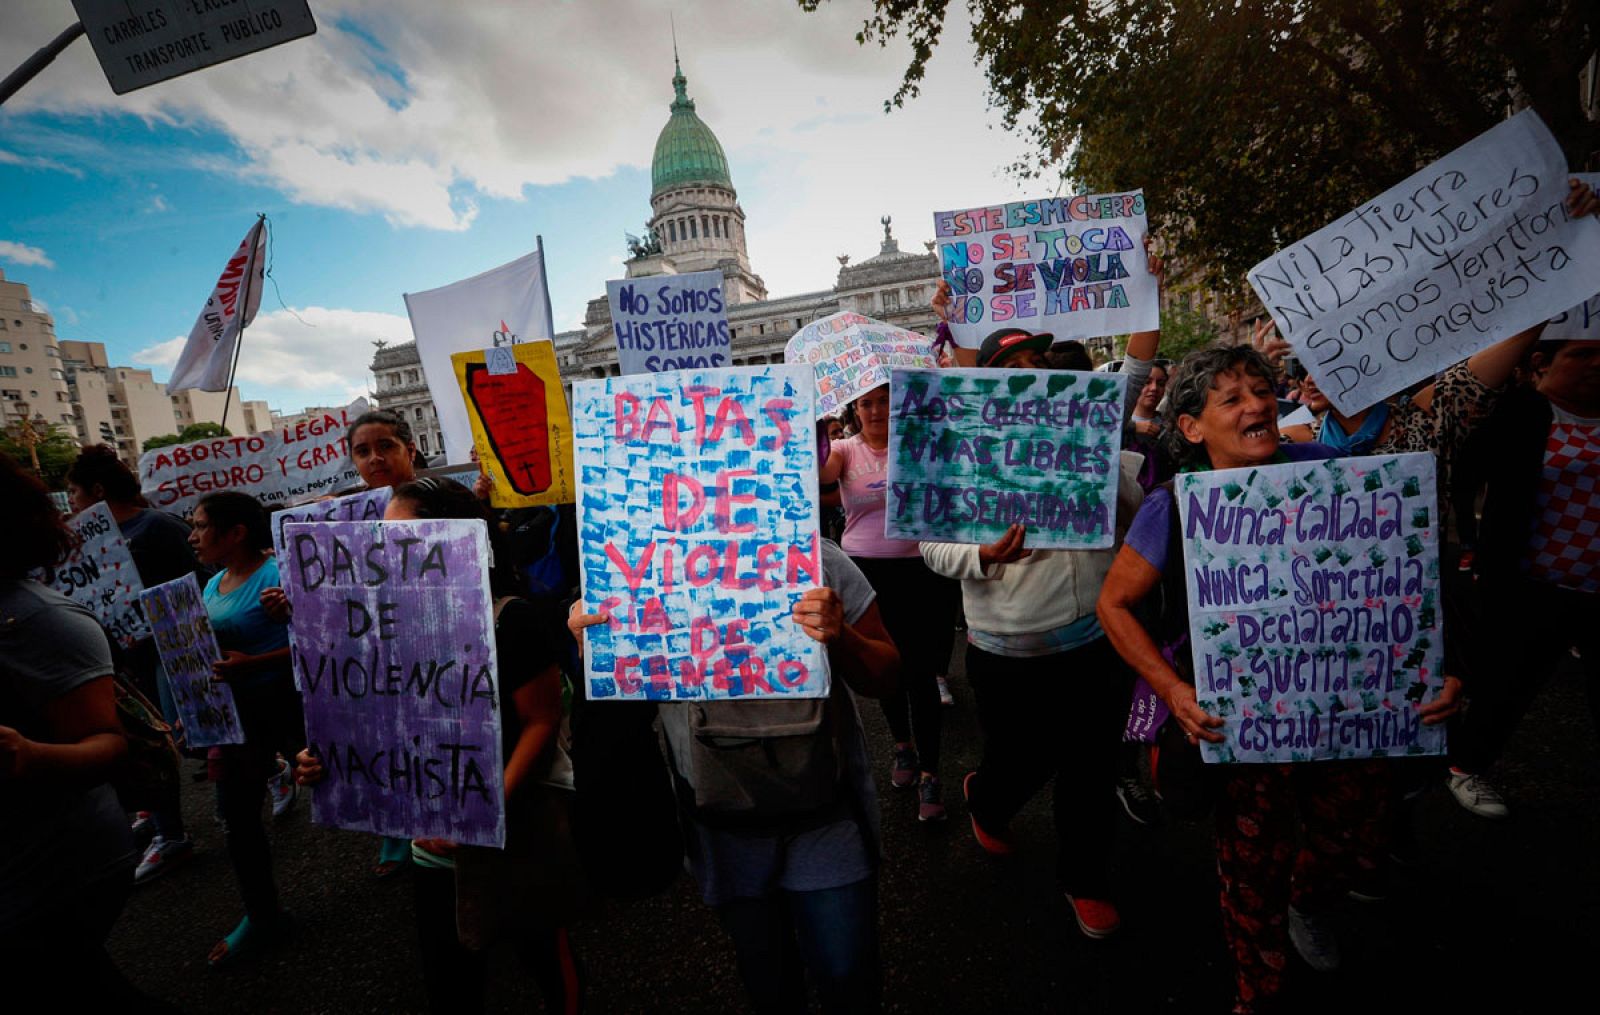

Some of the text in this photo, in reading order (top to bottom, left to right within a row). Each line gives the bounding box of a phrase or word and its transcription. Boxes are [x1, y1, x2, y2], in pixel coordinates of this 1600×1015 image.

[104, 8, 168, 45] CARRILES
[125, 32, 212, 75] TRANSPORTE
[934, 207, 1004, 238] ESTE
[1004, 202, 1040, 229] ES
[942, 226, 1135, 273] NO SE TOCA
[1254, 252, 1307, 300] Ni
[1303, 236, 1355, 275] La
[942, 267, 985, 296] NO
[992, 262, 1038, 294] SE
[990, 292, 1038, 322] SE
[1043, 281, 1130, 316] MATA
[1274, 285, 1326, 333] Ni
[1306, 277, 1442, 365] Somos
[1334, 354, 1383, 403] De
[283, 410, 354, 445] LEGAL
[899, 379, 1121, 433] NOS QUEREMOS
[157, 436, 350, 507] SEGURO Y GRAT
[287, 485, 306, 498] las
[307, 475, 341, 494] pobres
[663, 469, 760, 534] DE
[891, 482, 914, 519] Y
[1186, 487, 1403, 546] Nunca Callada
[59, 555, 101, 597] SON
[293, 534, 448, 593] BASTA
[346, 597, 400, 642] DE
[690, 617, 757, 660] DE
[614, 654, 810, 695] GENERO
[1363, 645, 1395, 693] al
